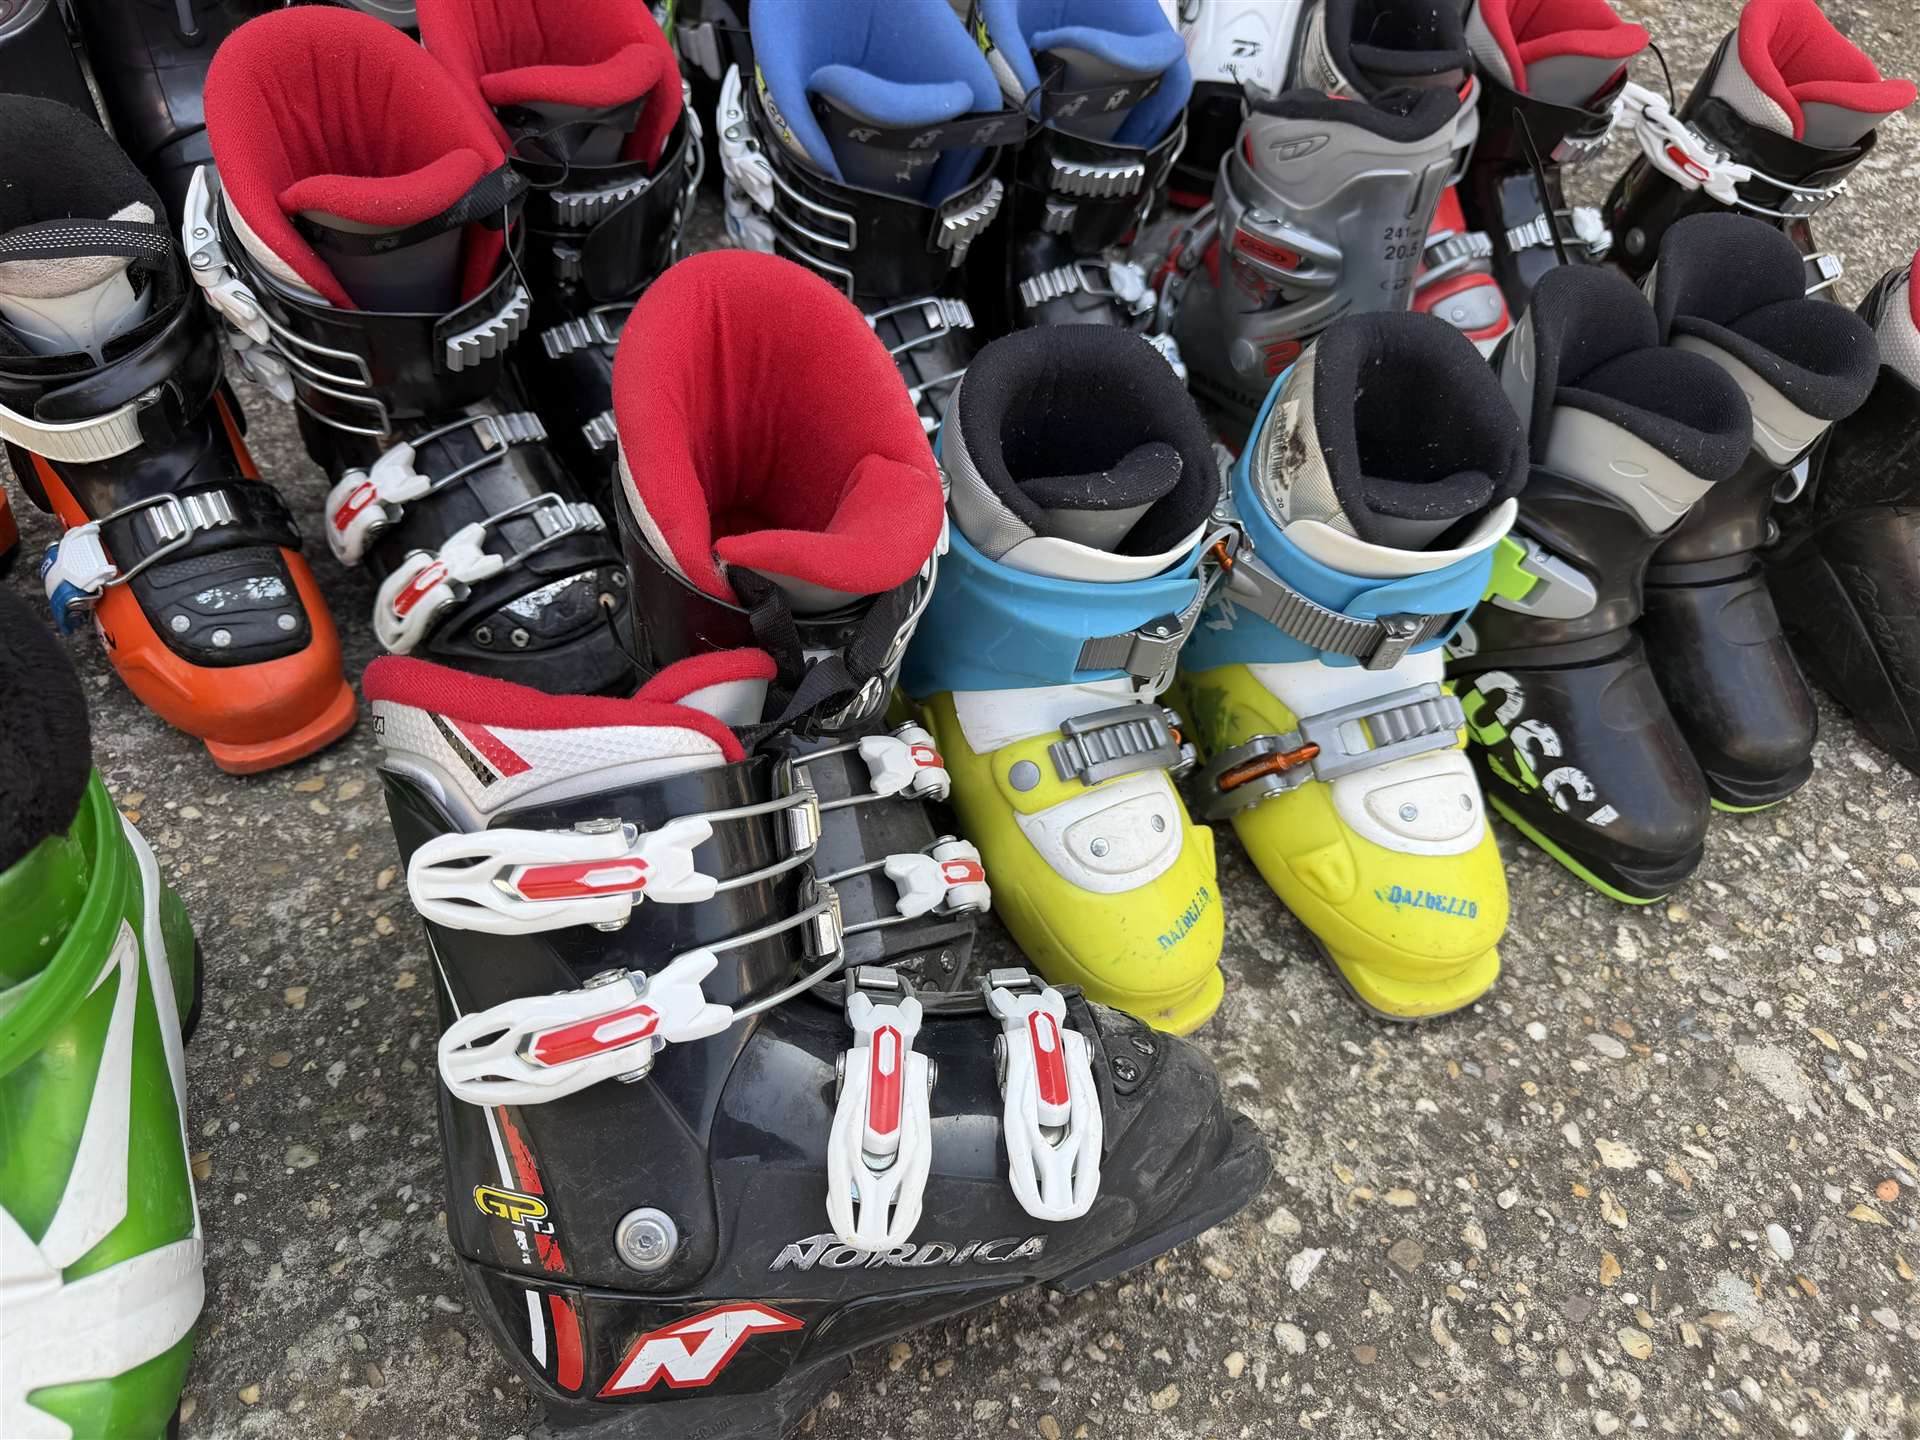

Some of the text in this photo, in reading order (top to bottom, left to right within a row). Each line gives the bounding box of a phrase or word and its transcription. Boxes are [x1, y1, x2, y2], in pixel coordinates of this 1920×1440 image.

[1383, 242, 1419, 260] 20.5
[473, 1184, 548, 1226] GP
[767, 1232, 1049, 1272] NORDICA
